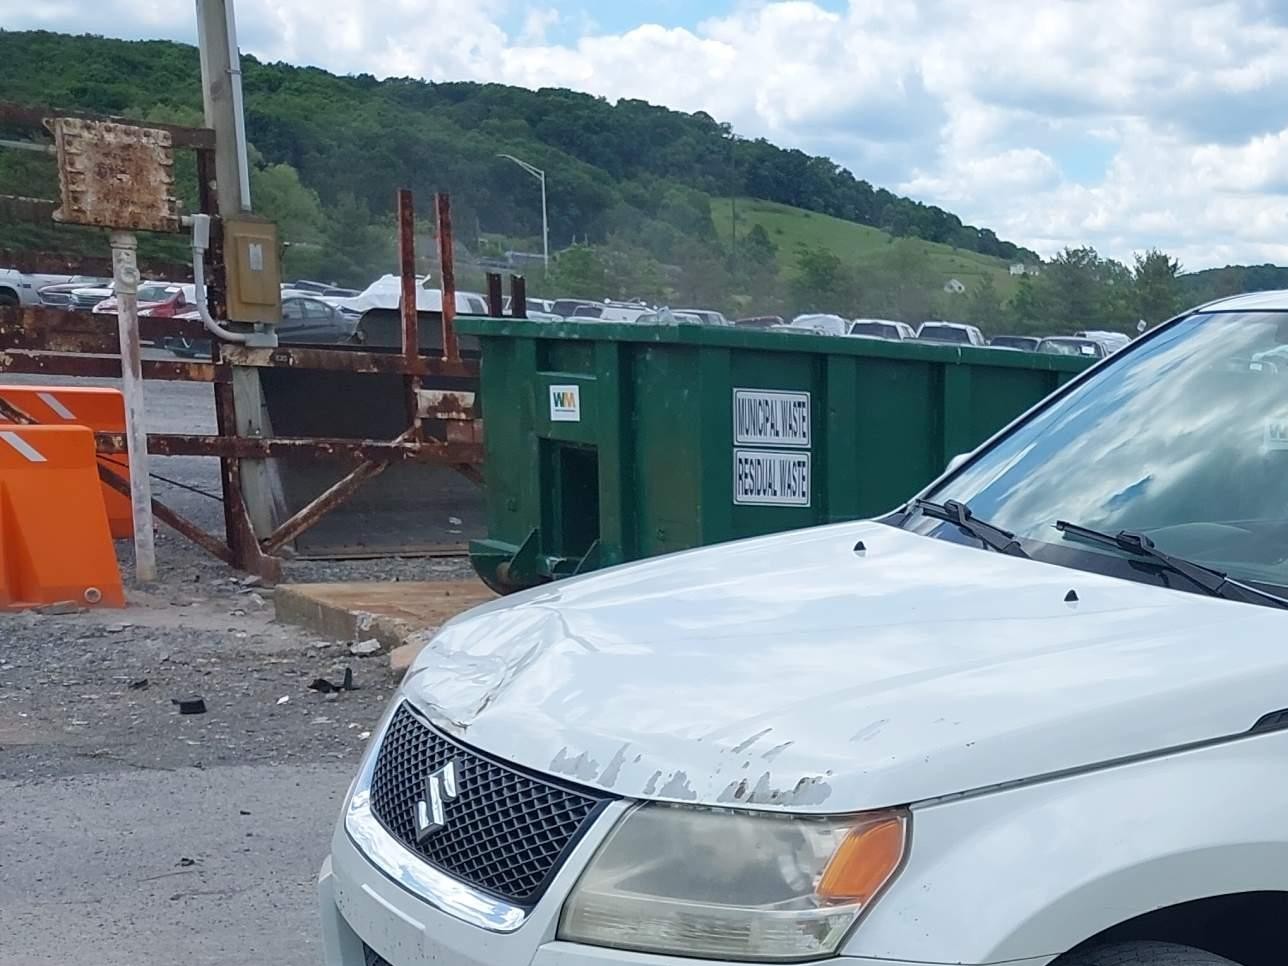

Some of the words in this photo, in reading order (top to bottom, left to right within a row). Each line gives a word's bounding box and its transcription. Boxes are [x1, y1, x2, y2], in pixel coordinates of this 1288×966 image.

[553, 391, 576, 408] WM
[737, 398, 780, 437] MUNICIPAL
[780, 400, 806, 438] WASTE
[738, 458, 777, 496] RESIDUAL
[779, 459, 806, 497] WASTE
